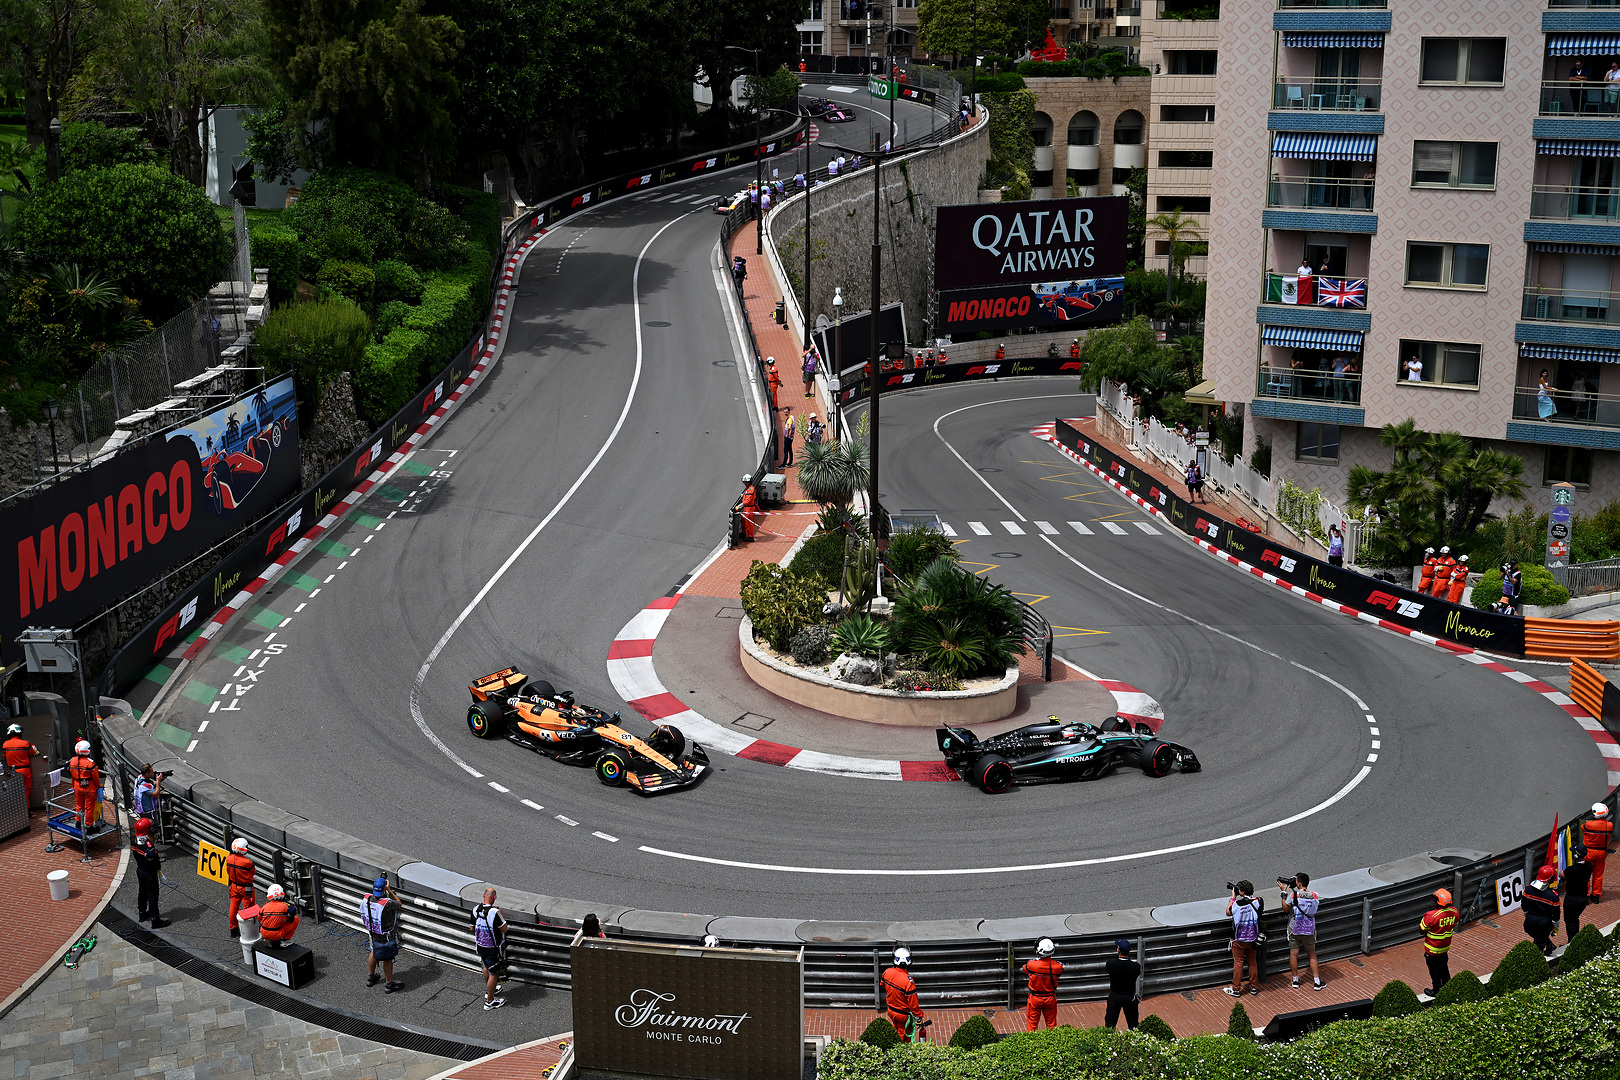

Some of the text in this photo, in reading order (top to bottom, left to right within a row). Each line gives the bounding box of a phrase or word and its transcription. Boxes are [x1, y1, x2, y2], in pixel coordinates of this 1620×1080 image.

[972, 208, 1095, 257] QATAR
[1000, 246, 1095, 274] AIRWAYS
[947, 295, 1031, 323] MONACO
[17, 459, 192, 619] MONACO
[214, 572, 241, 605] Monaco
[1309, 565, 1337, 591] Monaco
[1445, 610, 1495, 640] Monaco
[220, 643, 288, 711] TAXIS
[201, 848, 227, 879] FCY
[1501, 876, 1522, 908] SC
[615, 988, 752, 1035] Fairmont
[646, 1031, 722, 1045] MONTE CARLO
